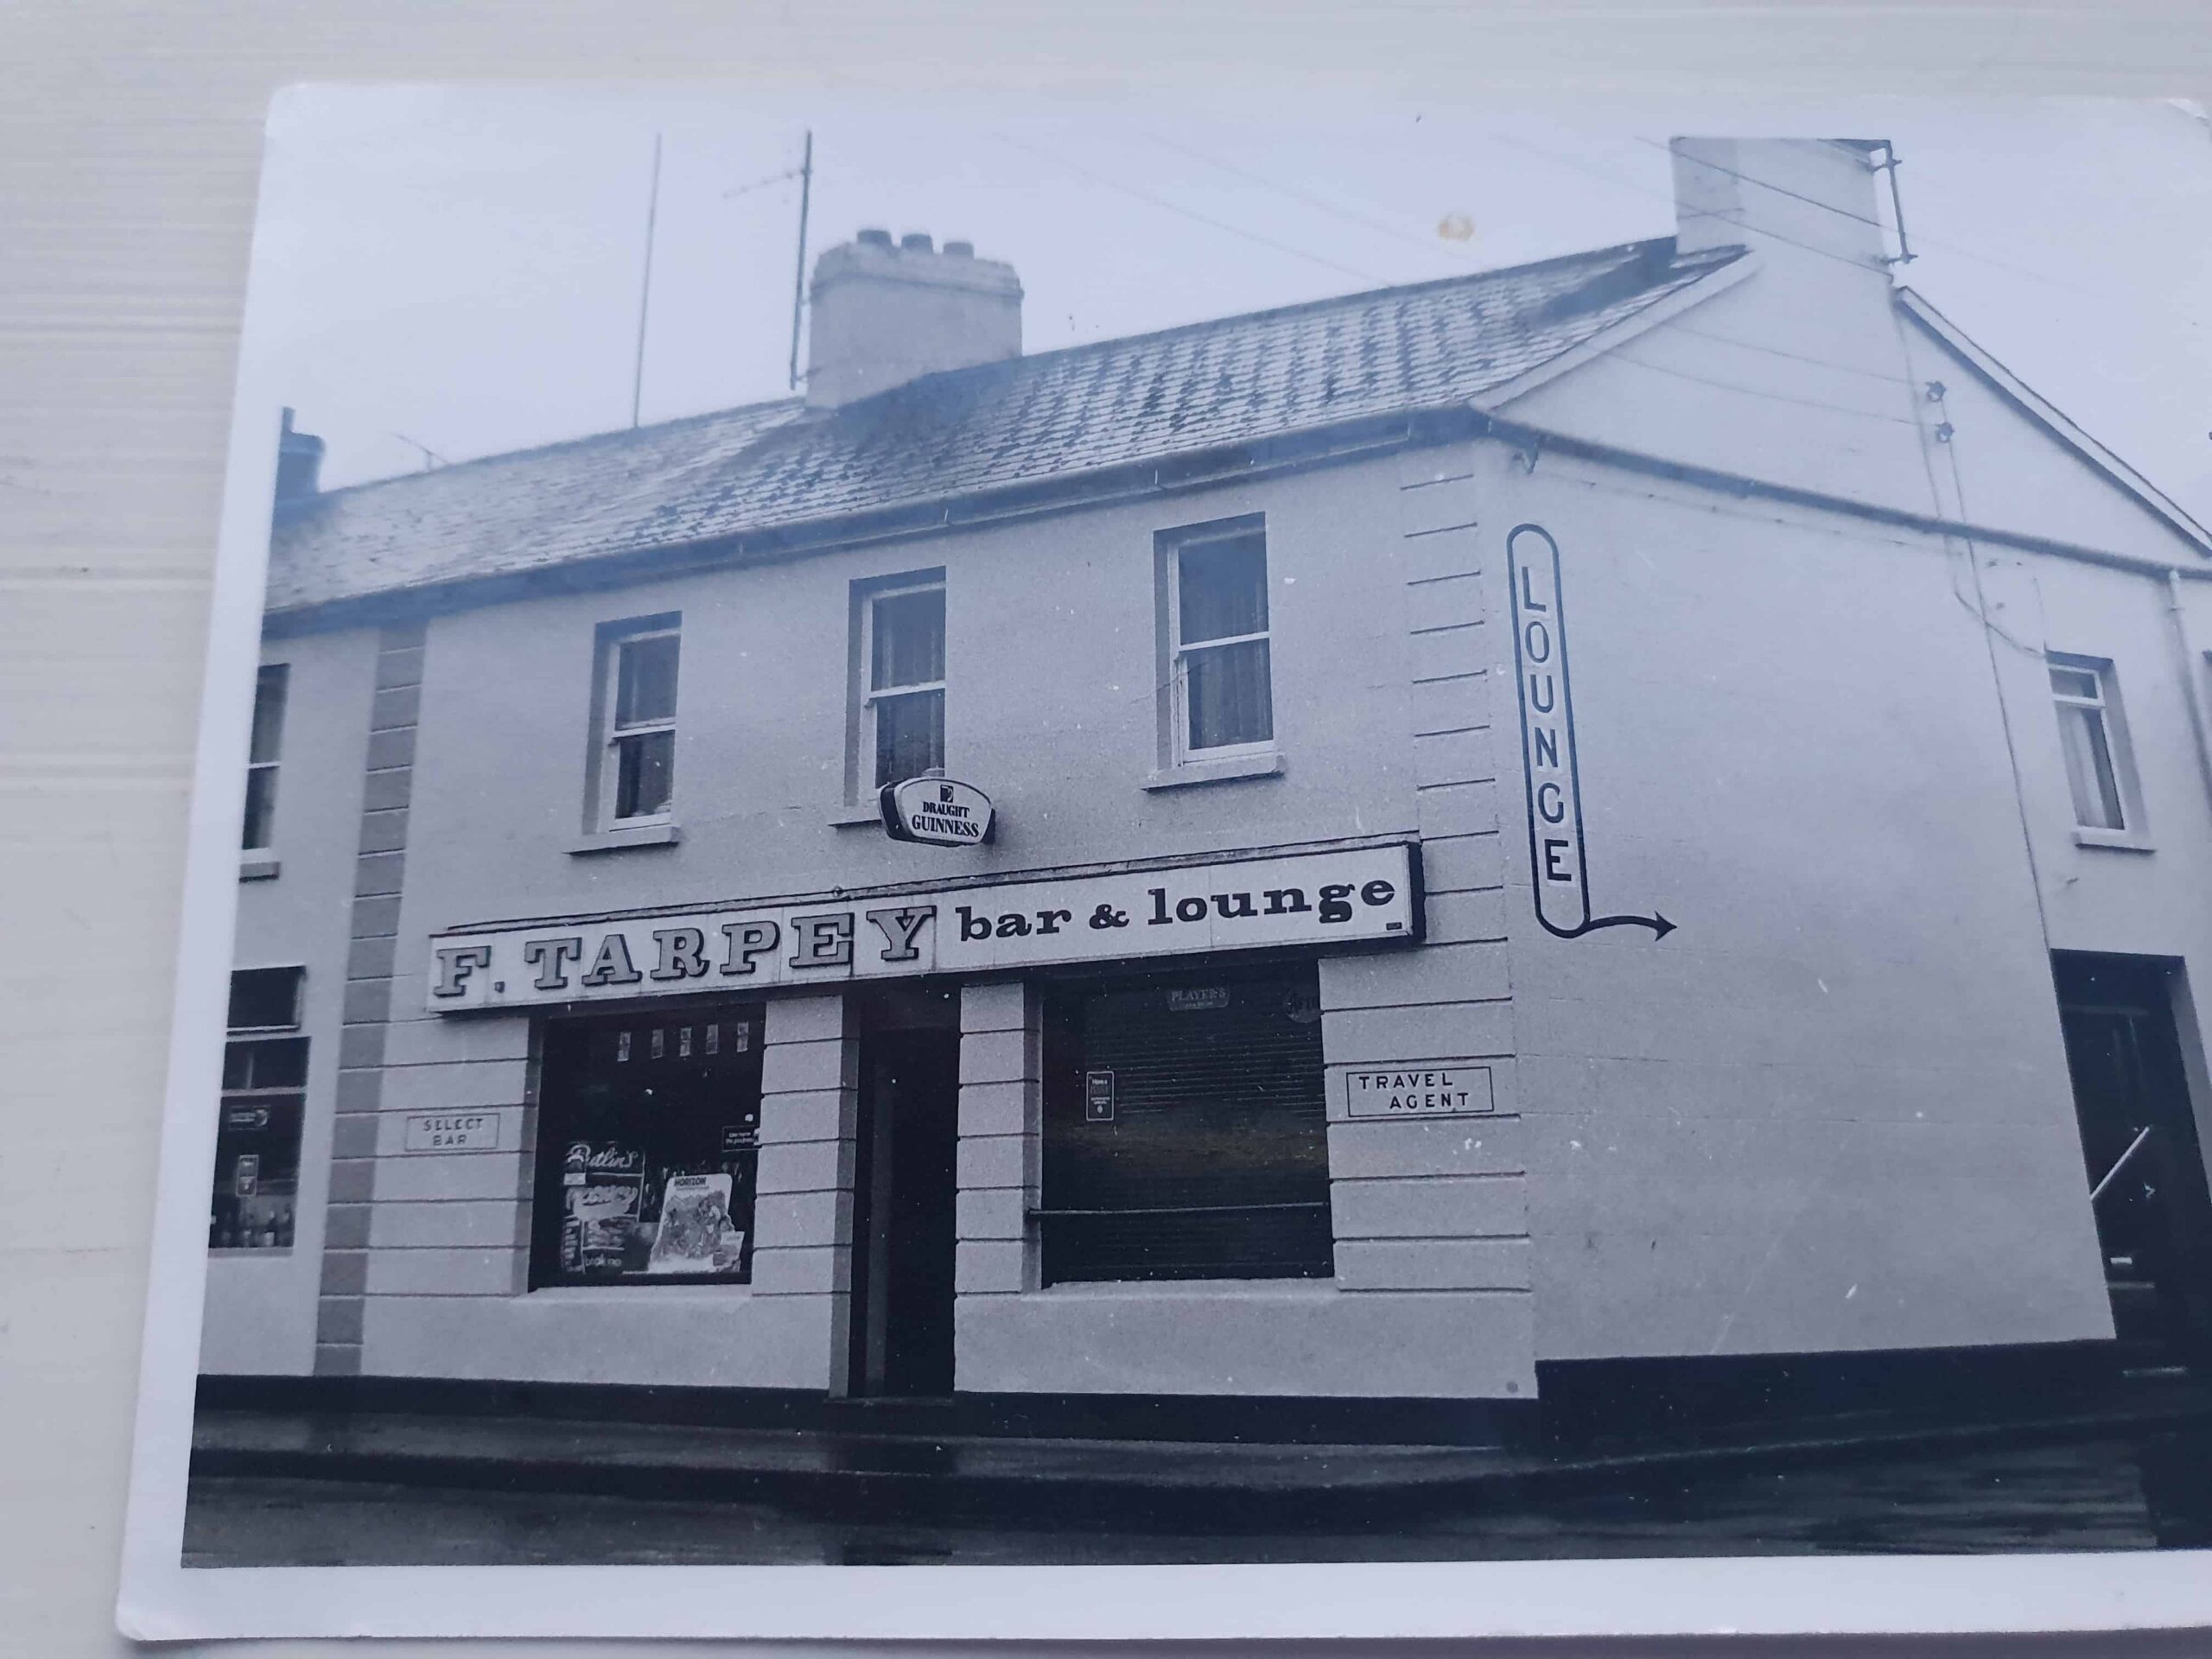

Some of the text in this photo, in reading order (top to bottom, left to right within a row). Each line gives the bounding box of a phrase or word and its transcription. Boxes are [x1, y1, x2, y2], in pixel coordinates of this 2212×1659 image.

[1521, 566, 1572, 882] LOUNGE
[923, 801, 969, 818] DRAUGHT
[912, 814, 980, 838] GUINNESS
[434, 879, 1396, 997] F. TARPEY bar & lounge
[1358, 1072, 1453, 1090] TRAVEL
[1389, 1092, 1469, 1109] AGENT
[423, 1118, 483, 1132] SELECT
[433, 1135, 467, 1146] BAR
[674, 1177, 707, 1187] HORIZON
